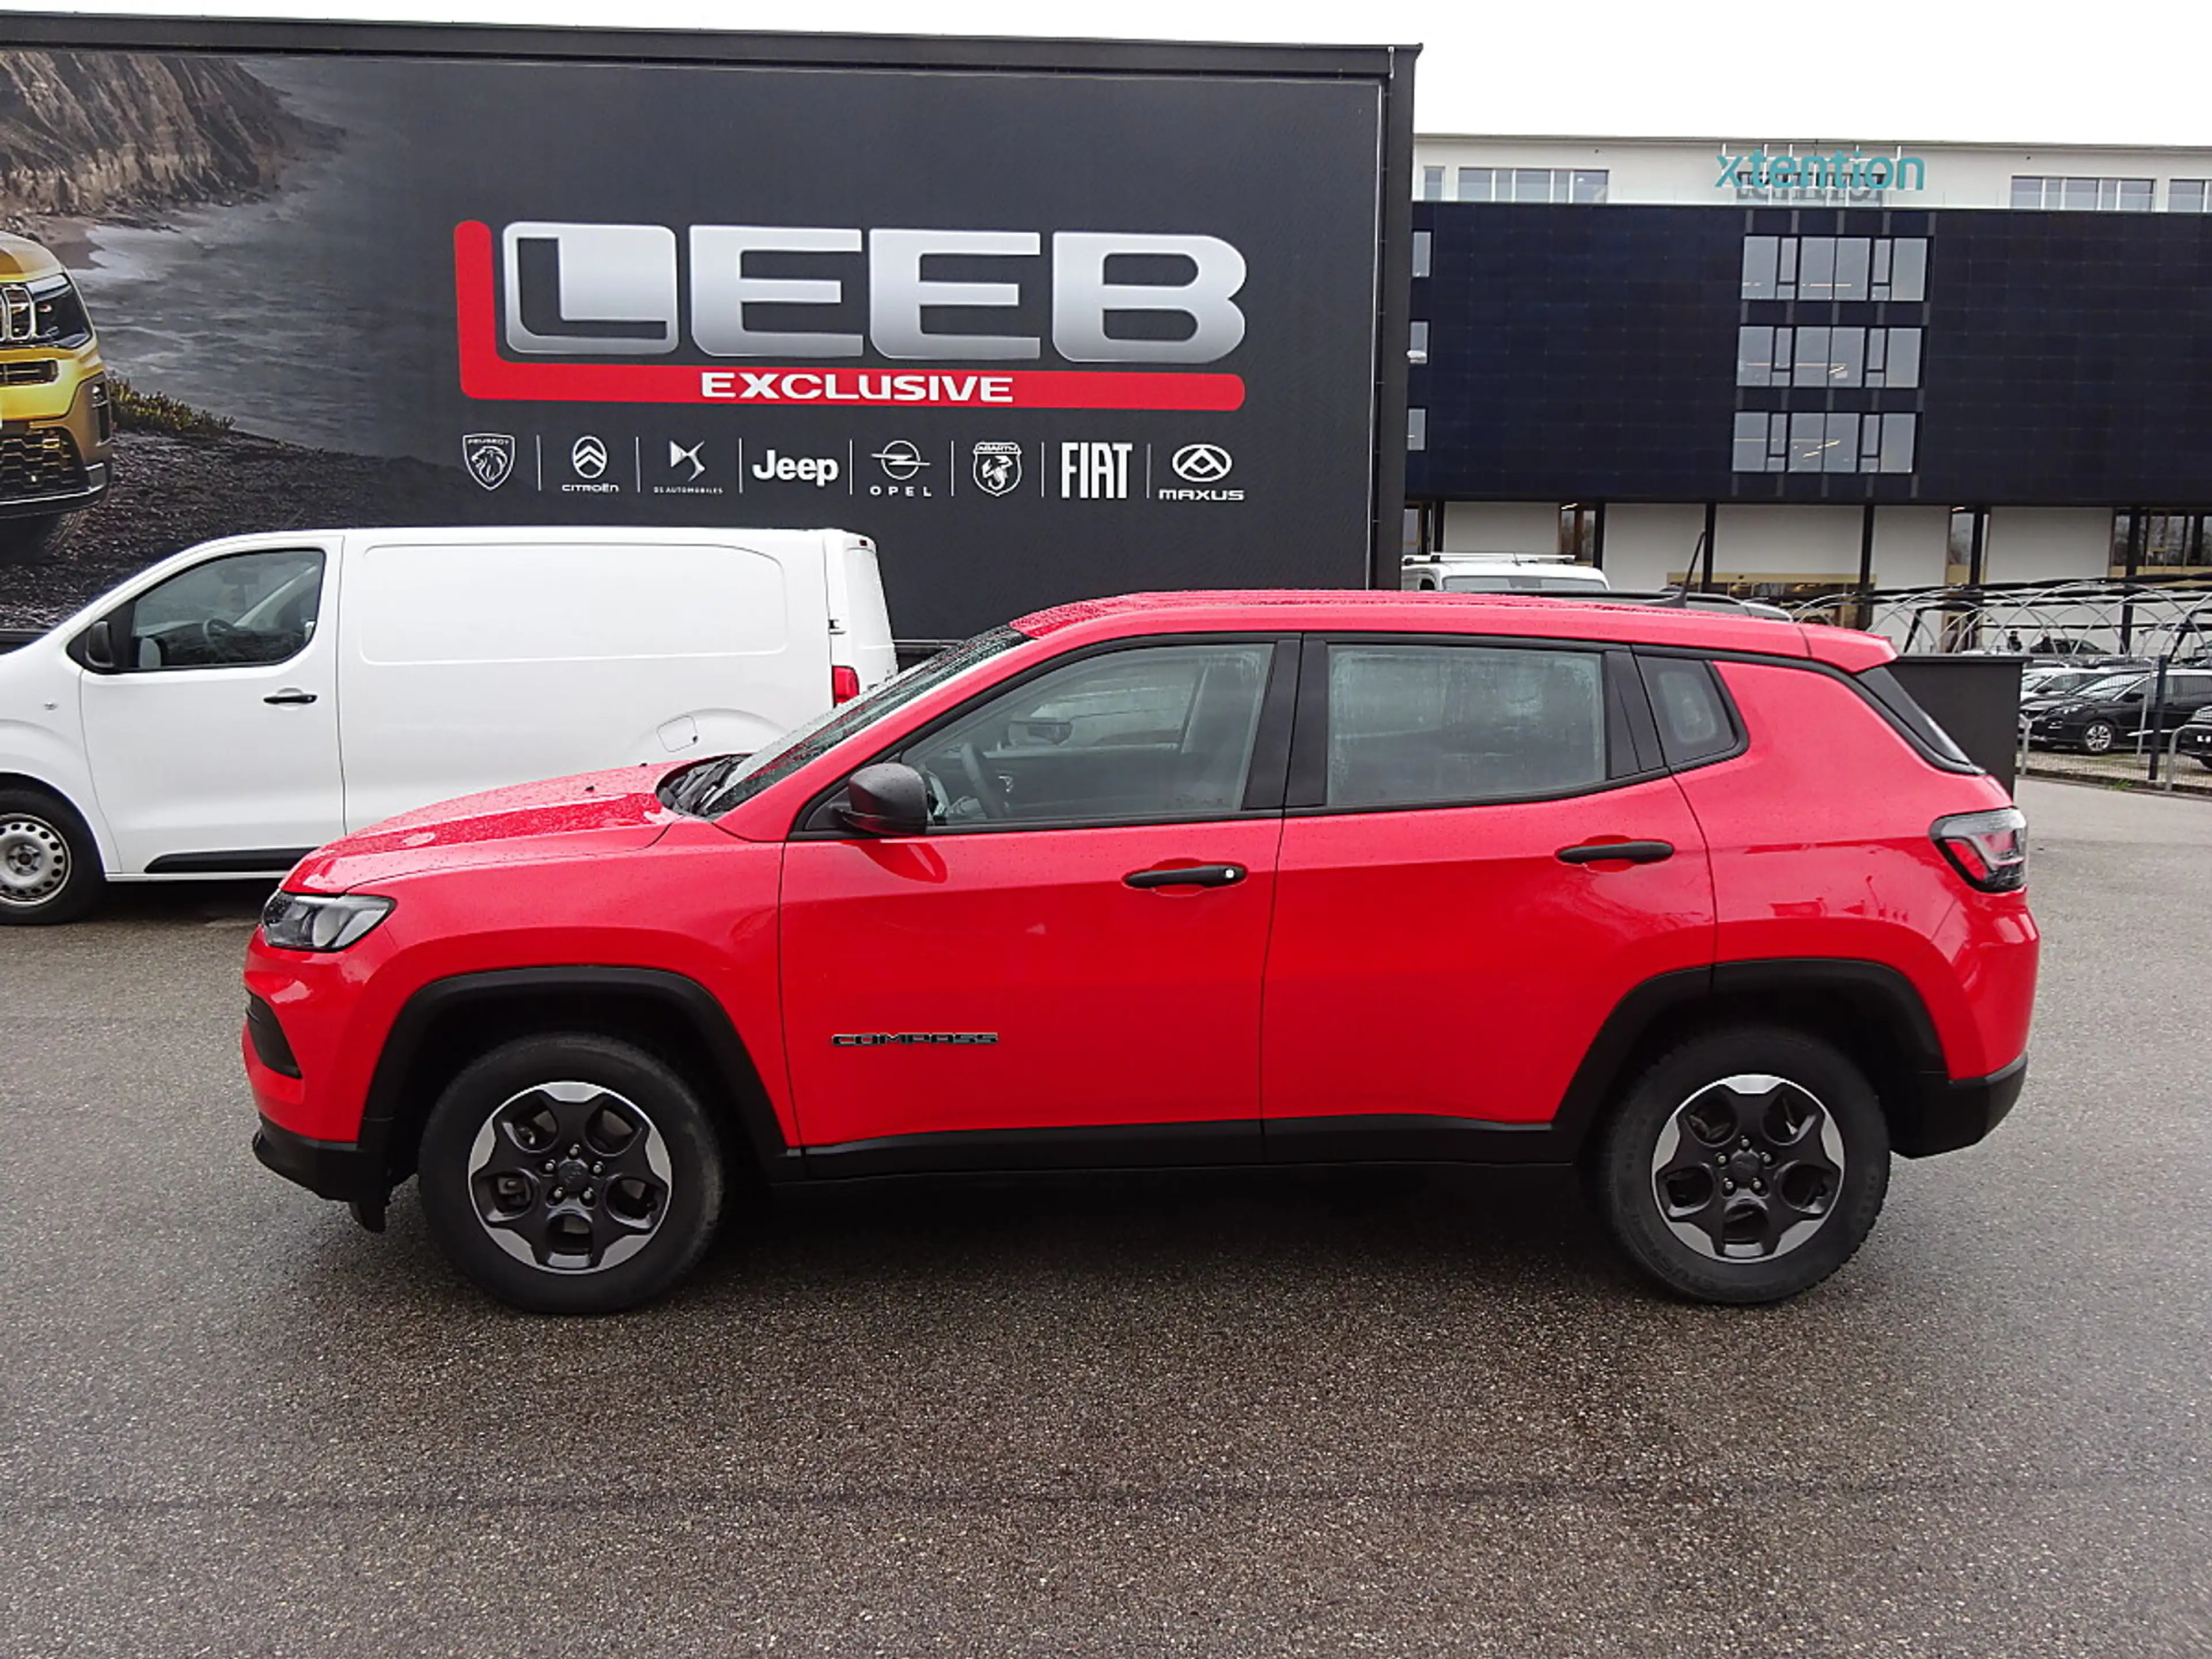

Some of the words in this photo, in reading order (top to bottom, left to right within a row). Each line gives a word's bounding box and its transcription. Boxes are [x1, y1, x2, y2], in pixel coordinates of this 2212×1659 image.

[1715, 149, 1925, 190] xtention
[503, 221, 1247, 364] LEEB
[701, 372, 1014, 403] EXCLUSIVE
[752, 449, 839, 487] Jeep
[1061, 442, 1133, 499] FIAT
[869, 485, 932, 497] OPEL
[1158, 488, 1244, 501] MAXUS
[831, 1032, 999, 1046] COMPASS
